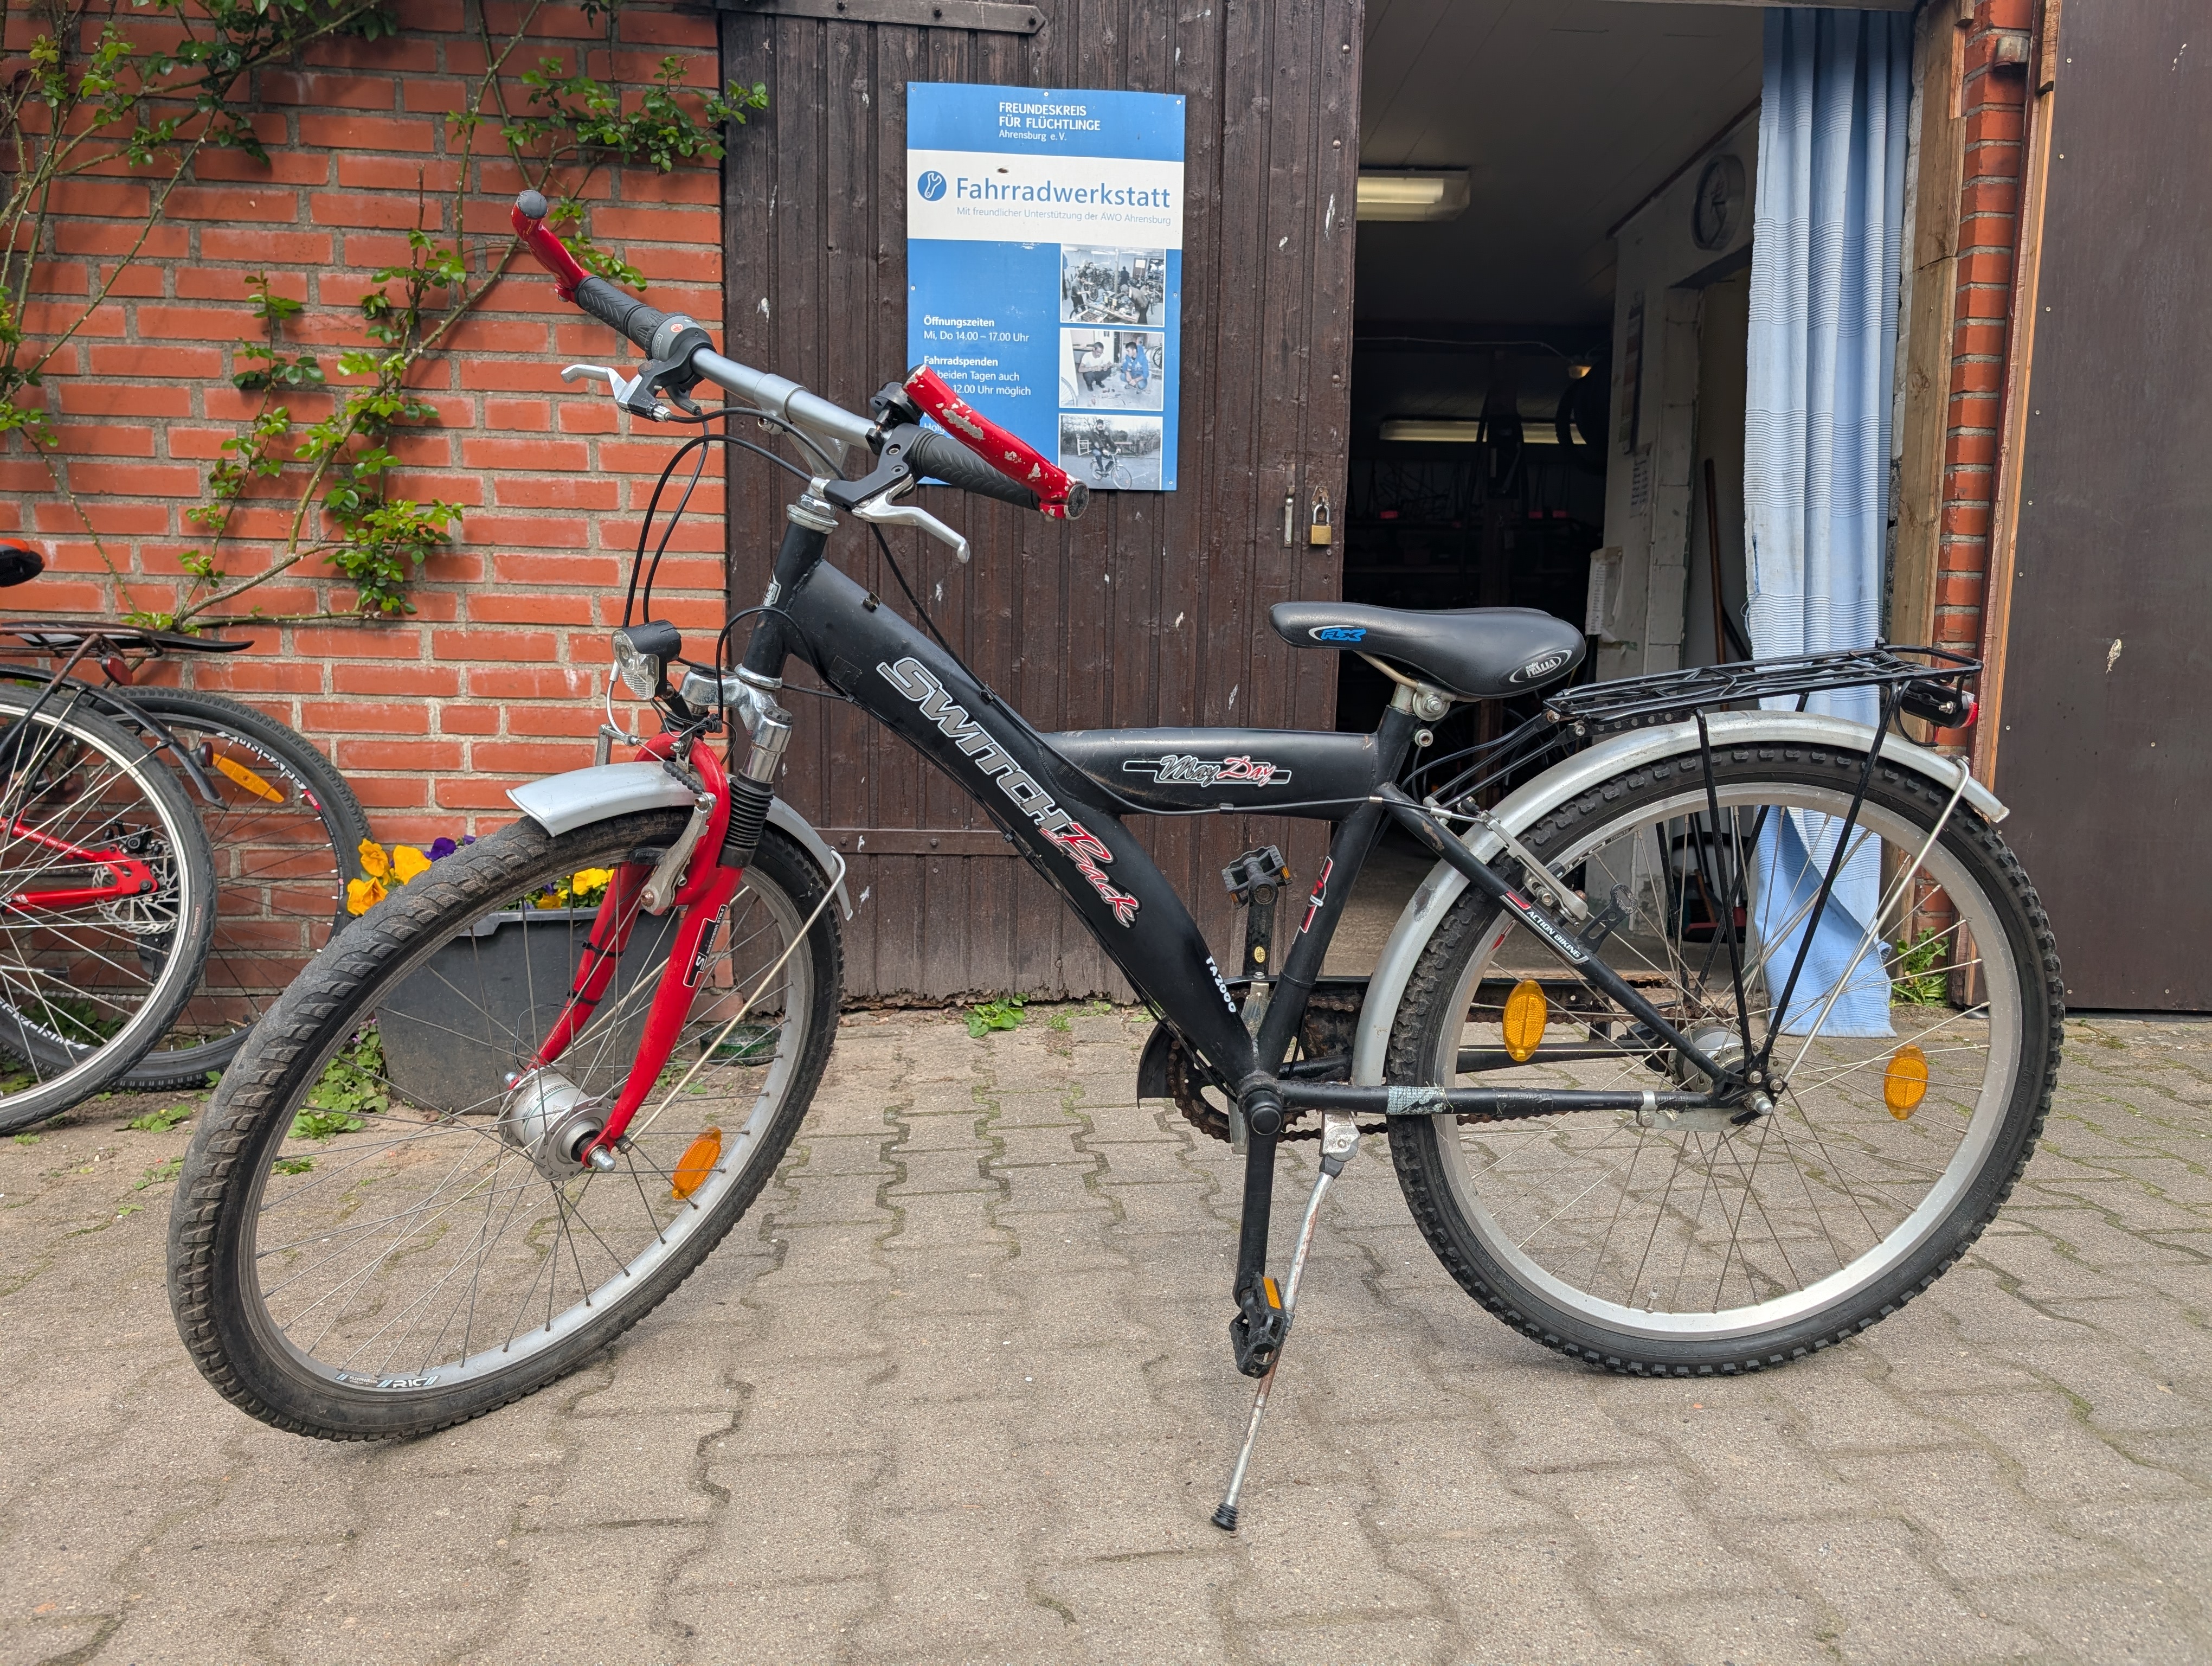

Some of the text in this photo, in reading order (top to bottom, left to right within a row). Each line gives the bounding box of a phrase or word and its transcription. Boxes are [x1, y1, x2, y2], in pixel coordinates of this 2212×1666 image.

[999, 102, 1086, 117] FREUNDESKREIS
[999, 114, 1101, 131] FÜR FLÜCHTLINGE
[999, 130, 1047, 142] Ahrensburg
[956, 177, 1171, 208] Fahrradwerkstatt
[956, 207, 1171, 226] Mit freundlicher Unterstützung der AWO Ahrensburg
[923, 315, 995, 329] Öffnungszeiten
[924, 331, 937, 341] Mi,
[940, 331, 953, 340] Do
[956, 331, 979, 341] 14.00
[988, 332, 1011, 342] 17.00
[1013, 333, 1030, 342] Uhr
[923, 355, 998, 368] Fahrradspenden
[937, 370, 1020, 382] beiden Tagen auch
[953, 384, 1031, 397] 12.00 Uhr möglich
[1525, 658, 1557, 677] ITALIA
[706, 922, 720, 955] SUSPENSION
[1526, 910, 1582, 959] ACTION BIKING
[1205, 955, 1237, 1013] TA2000
[536, 1083, 570, 1103] SHIMANO
